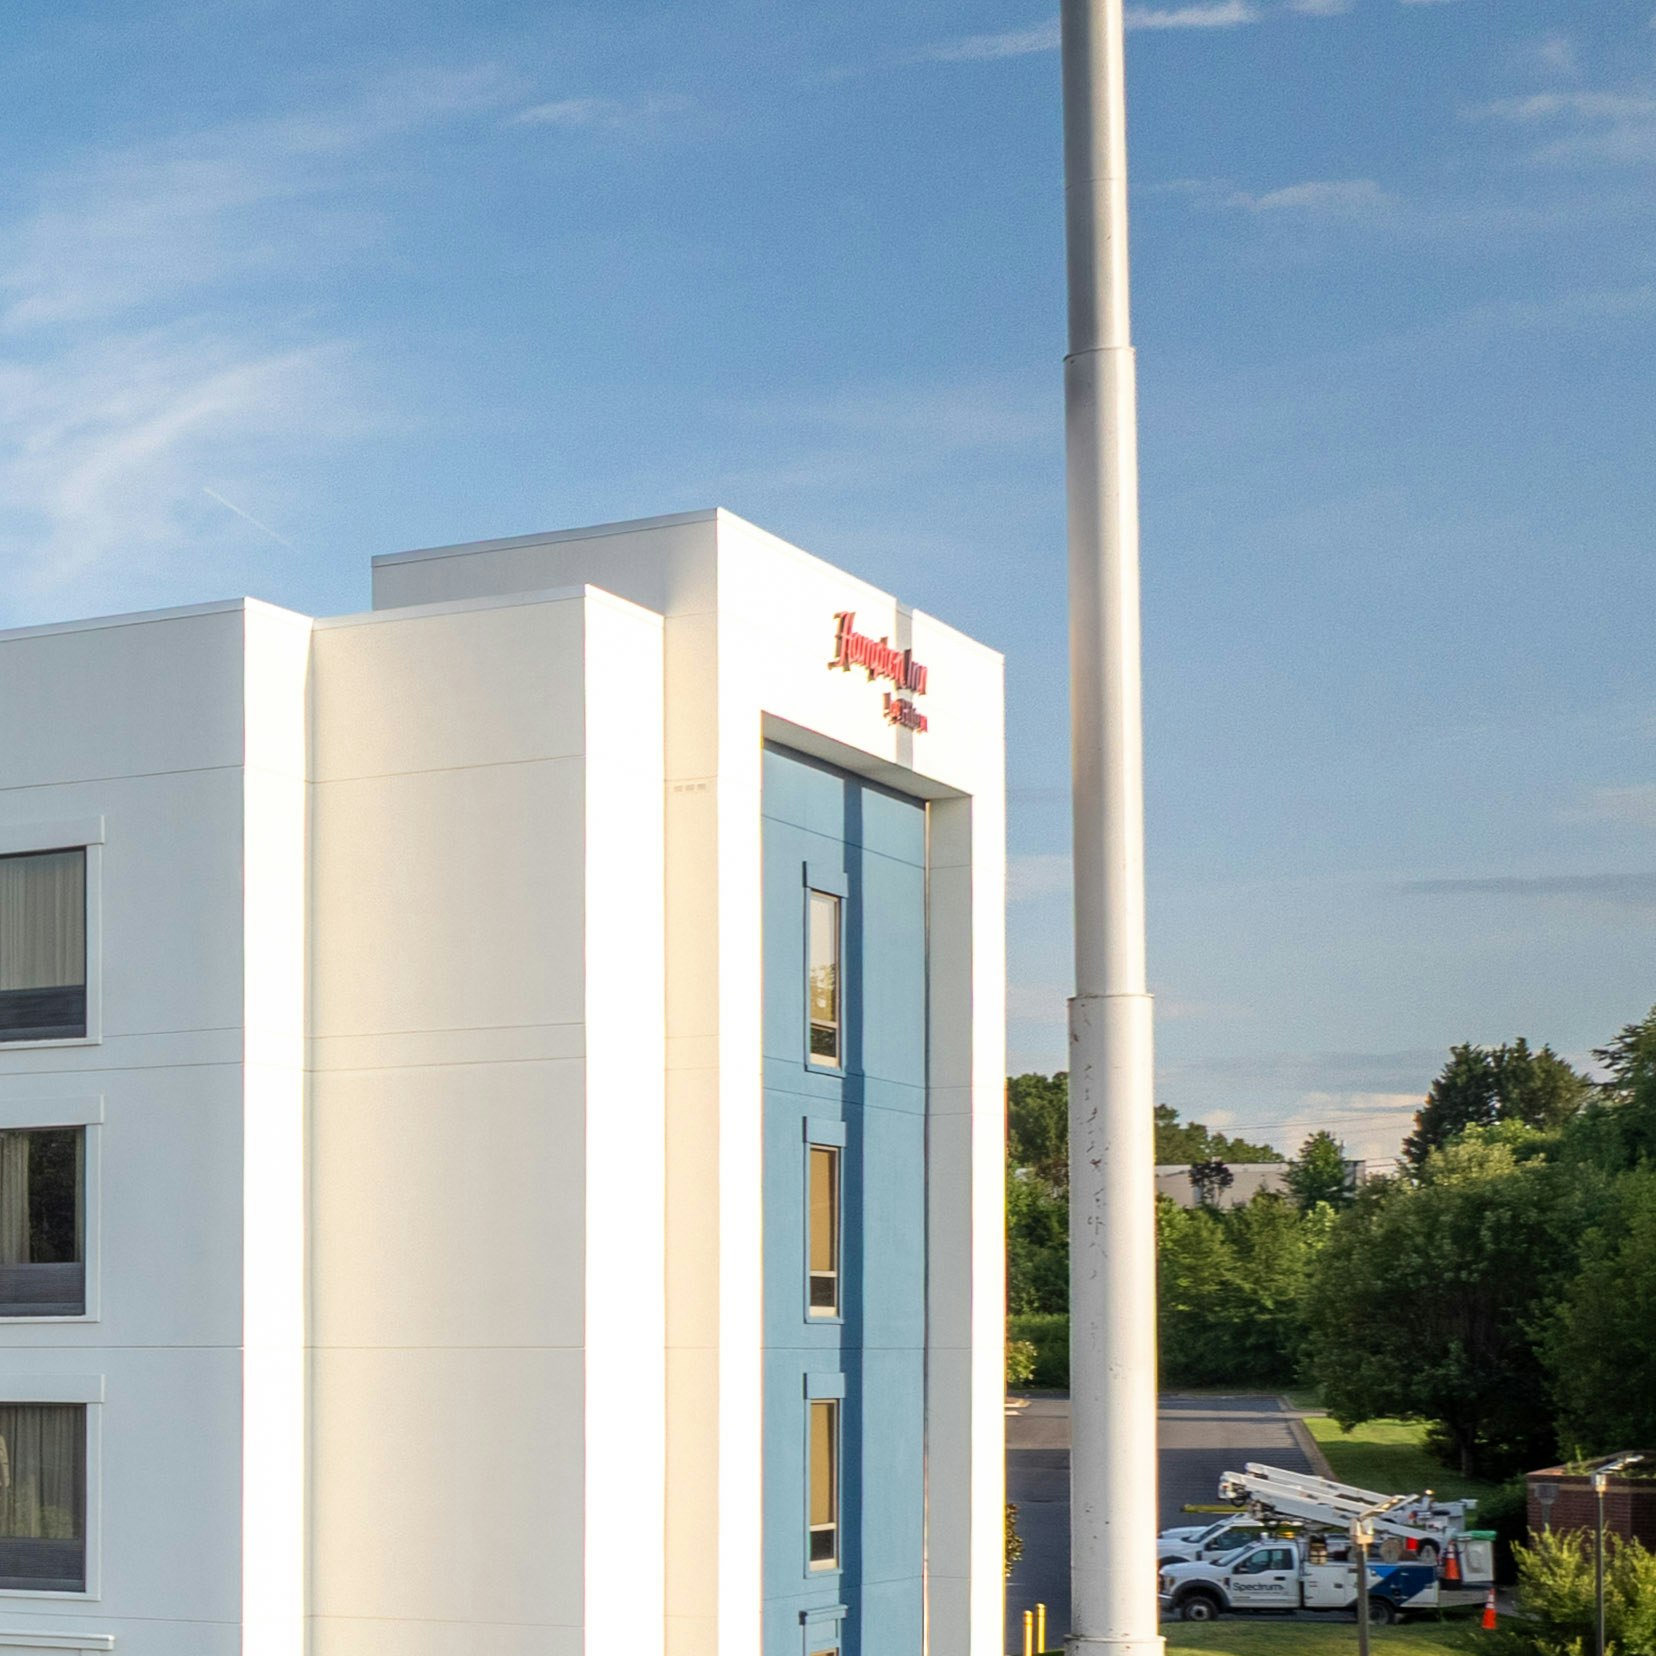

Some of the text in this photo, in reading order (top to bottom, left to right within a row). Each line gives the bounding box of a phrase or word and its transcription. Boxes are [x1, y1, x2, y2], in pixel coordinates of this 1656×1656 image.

[828, 611, 928, 696] Hampton Inn
[1233, 1582, 1282, 1592] Spectrum
